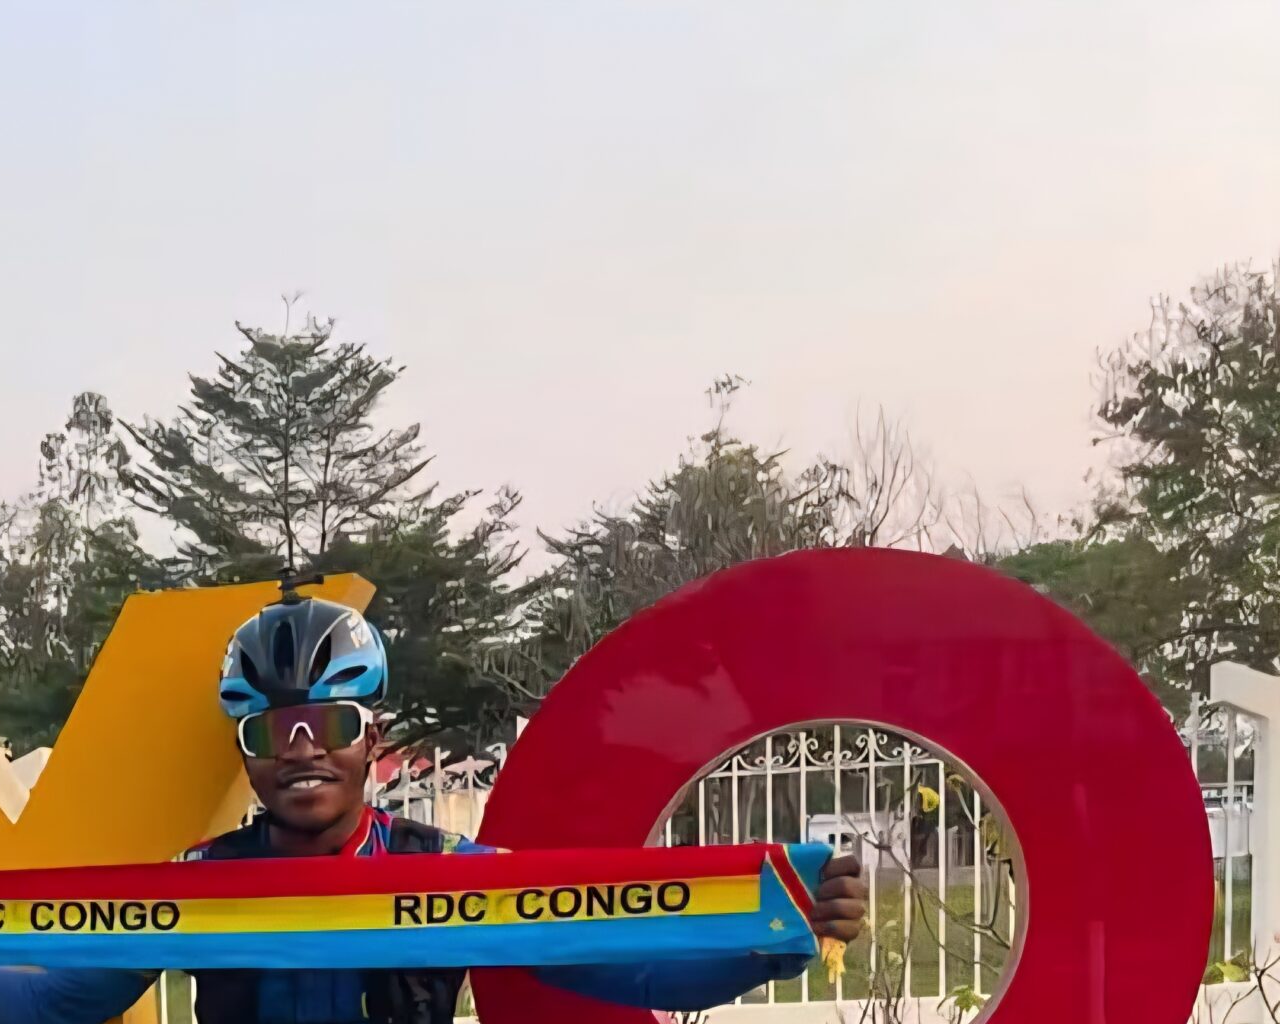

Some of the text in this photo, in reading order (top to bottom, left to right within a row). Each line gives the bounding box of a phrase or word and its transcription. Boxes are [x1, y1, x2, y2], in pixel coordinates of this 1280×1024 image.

[30, 901, 181, 931] CONGO
[394, 881, 690, 925] RDC CONGO
